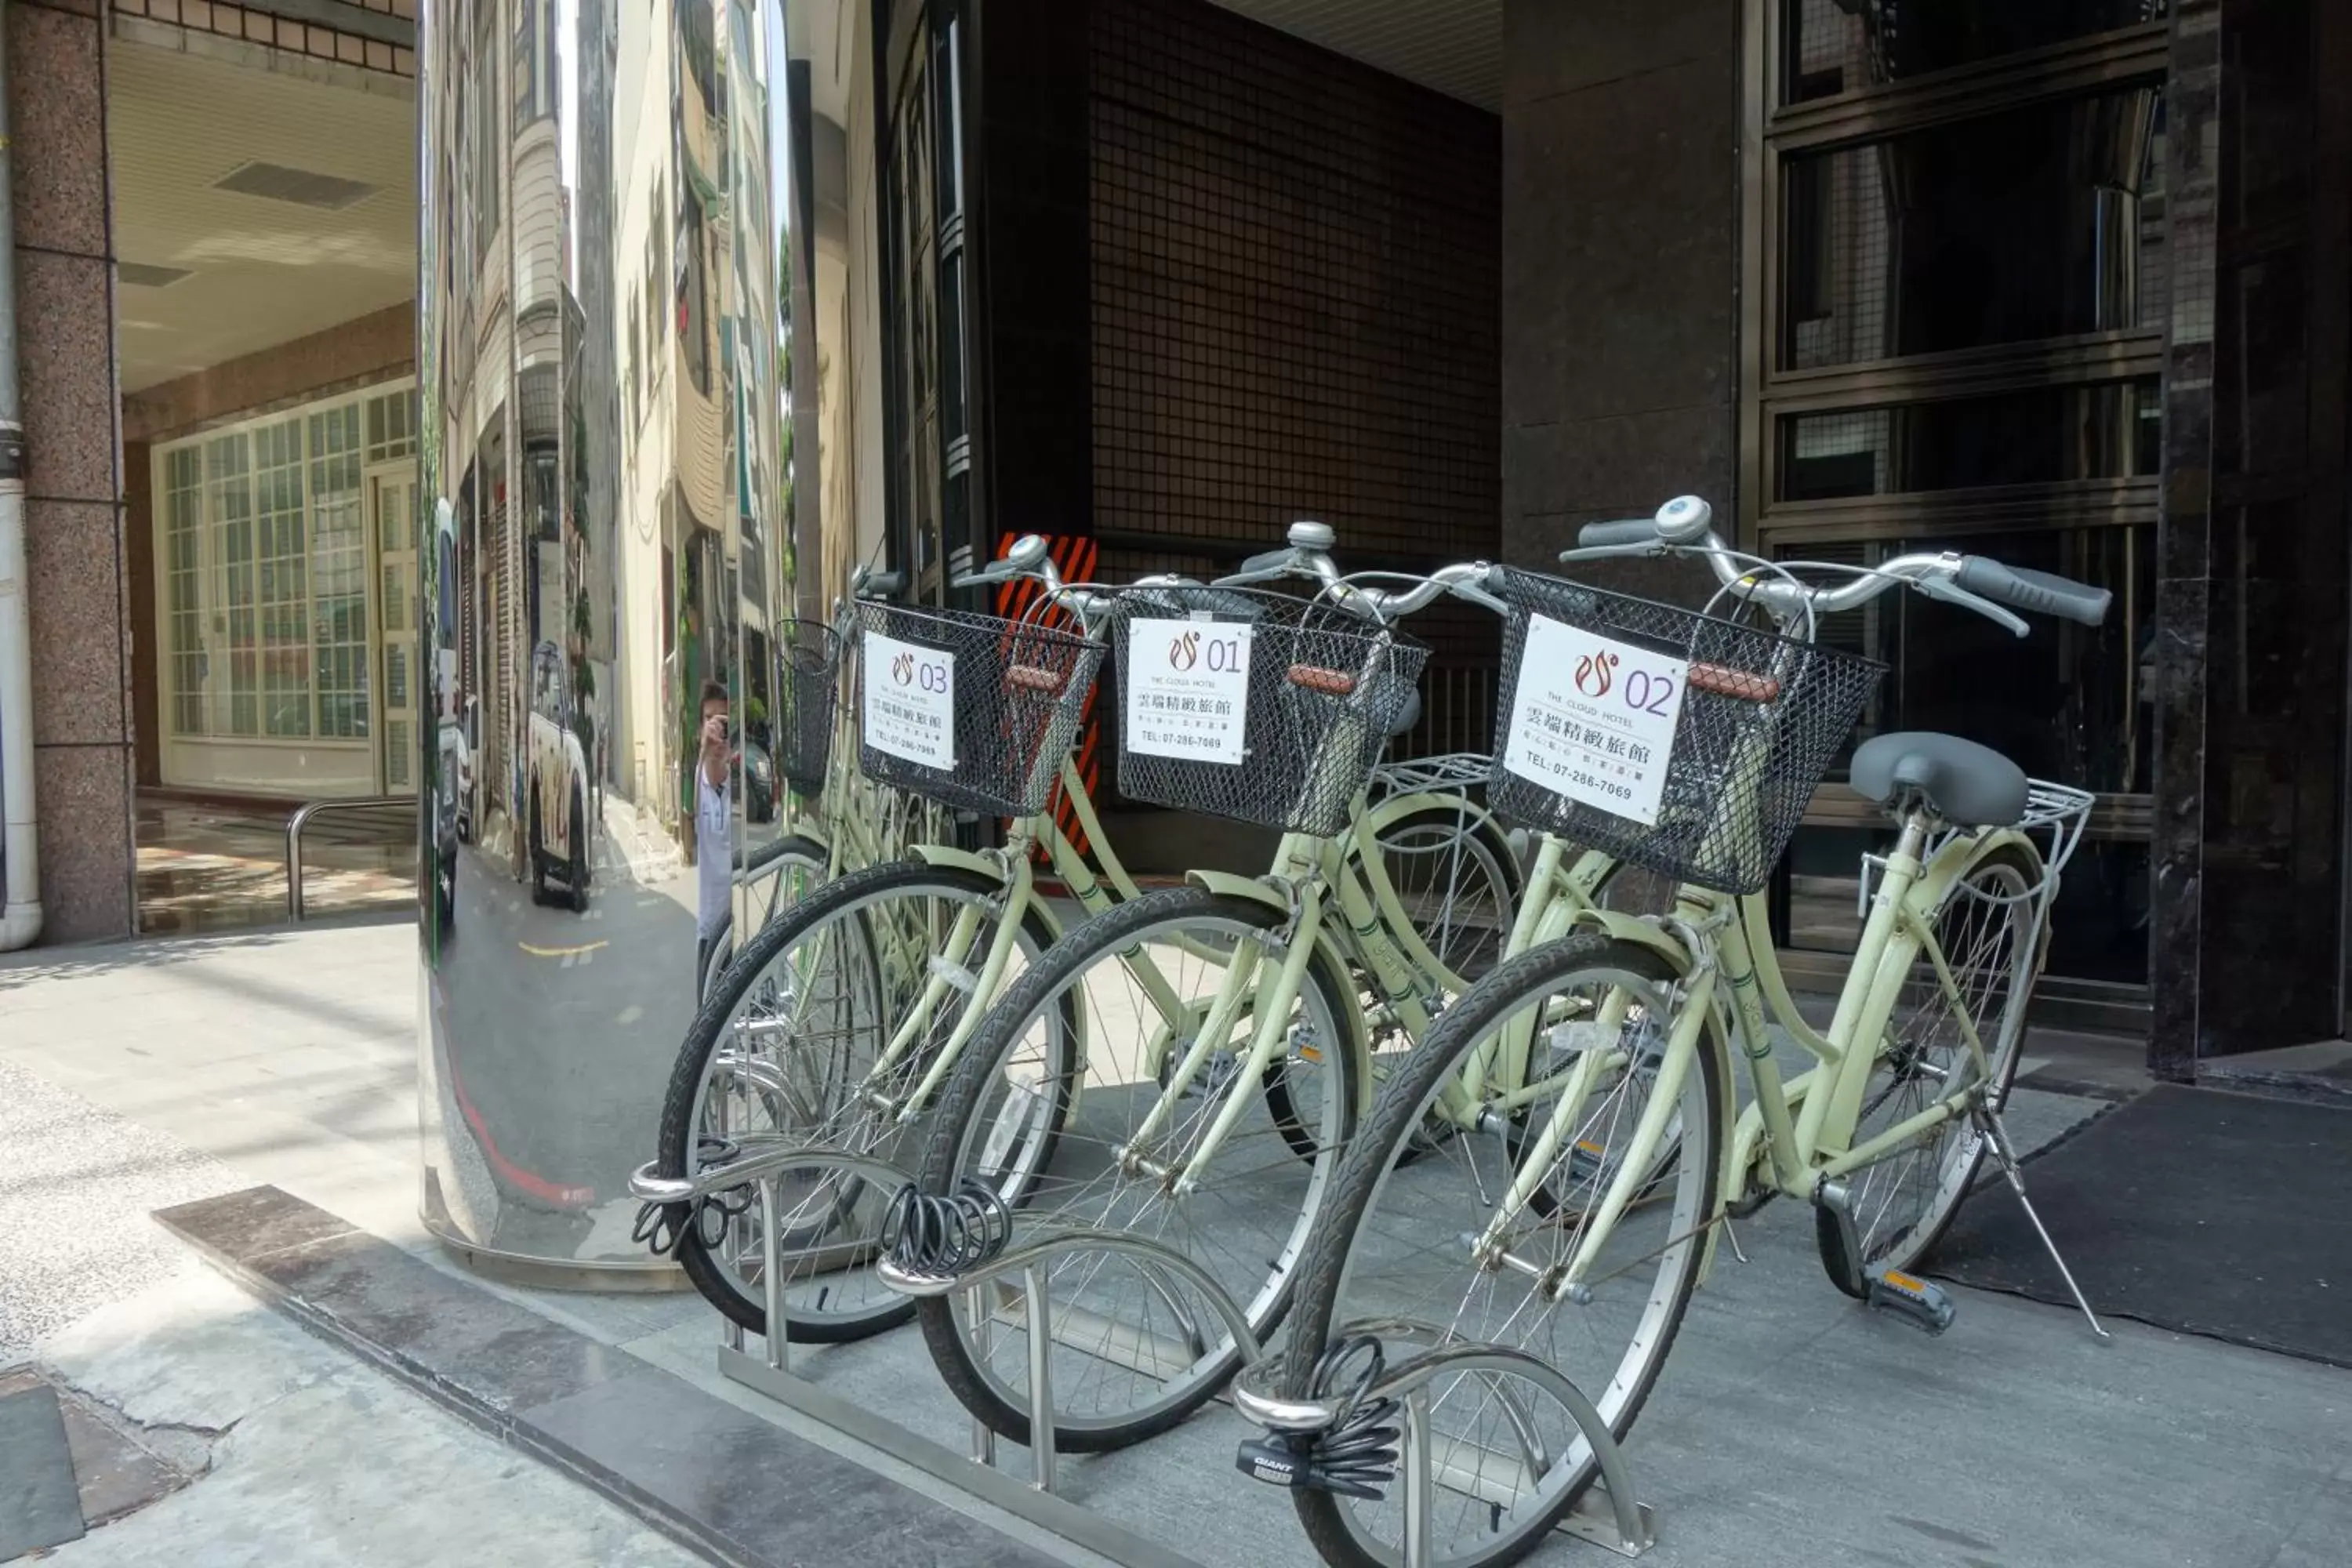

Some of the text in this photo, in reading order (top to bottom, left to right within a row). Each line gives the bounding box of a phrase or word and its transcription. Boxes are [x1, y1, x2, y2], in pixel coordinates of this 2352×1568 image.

[1207, 639, 1243, 673] 01
[920, 662, 946, 694] 03
[1625, 670, 1673, 717] 02
[1548, 691, 1633, 729] THE CLOUD HOTEL
[1527, 706, 1651, 764] 雲端精緻旅館
[1254, 1457, 1294, 1472] GIANT
